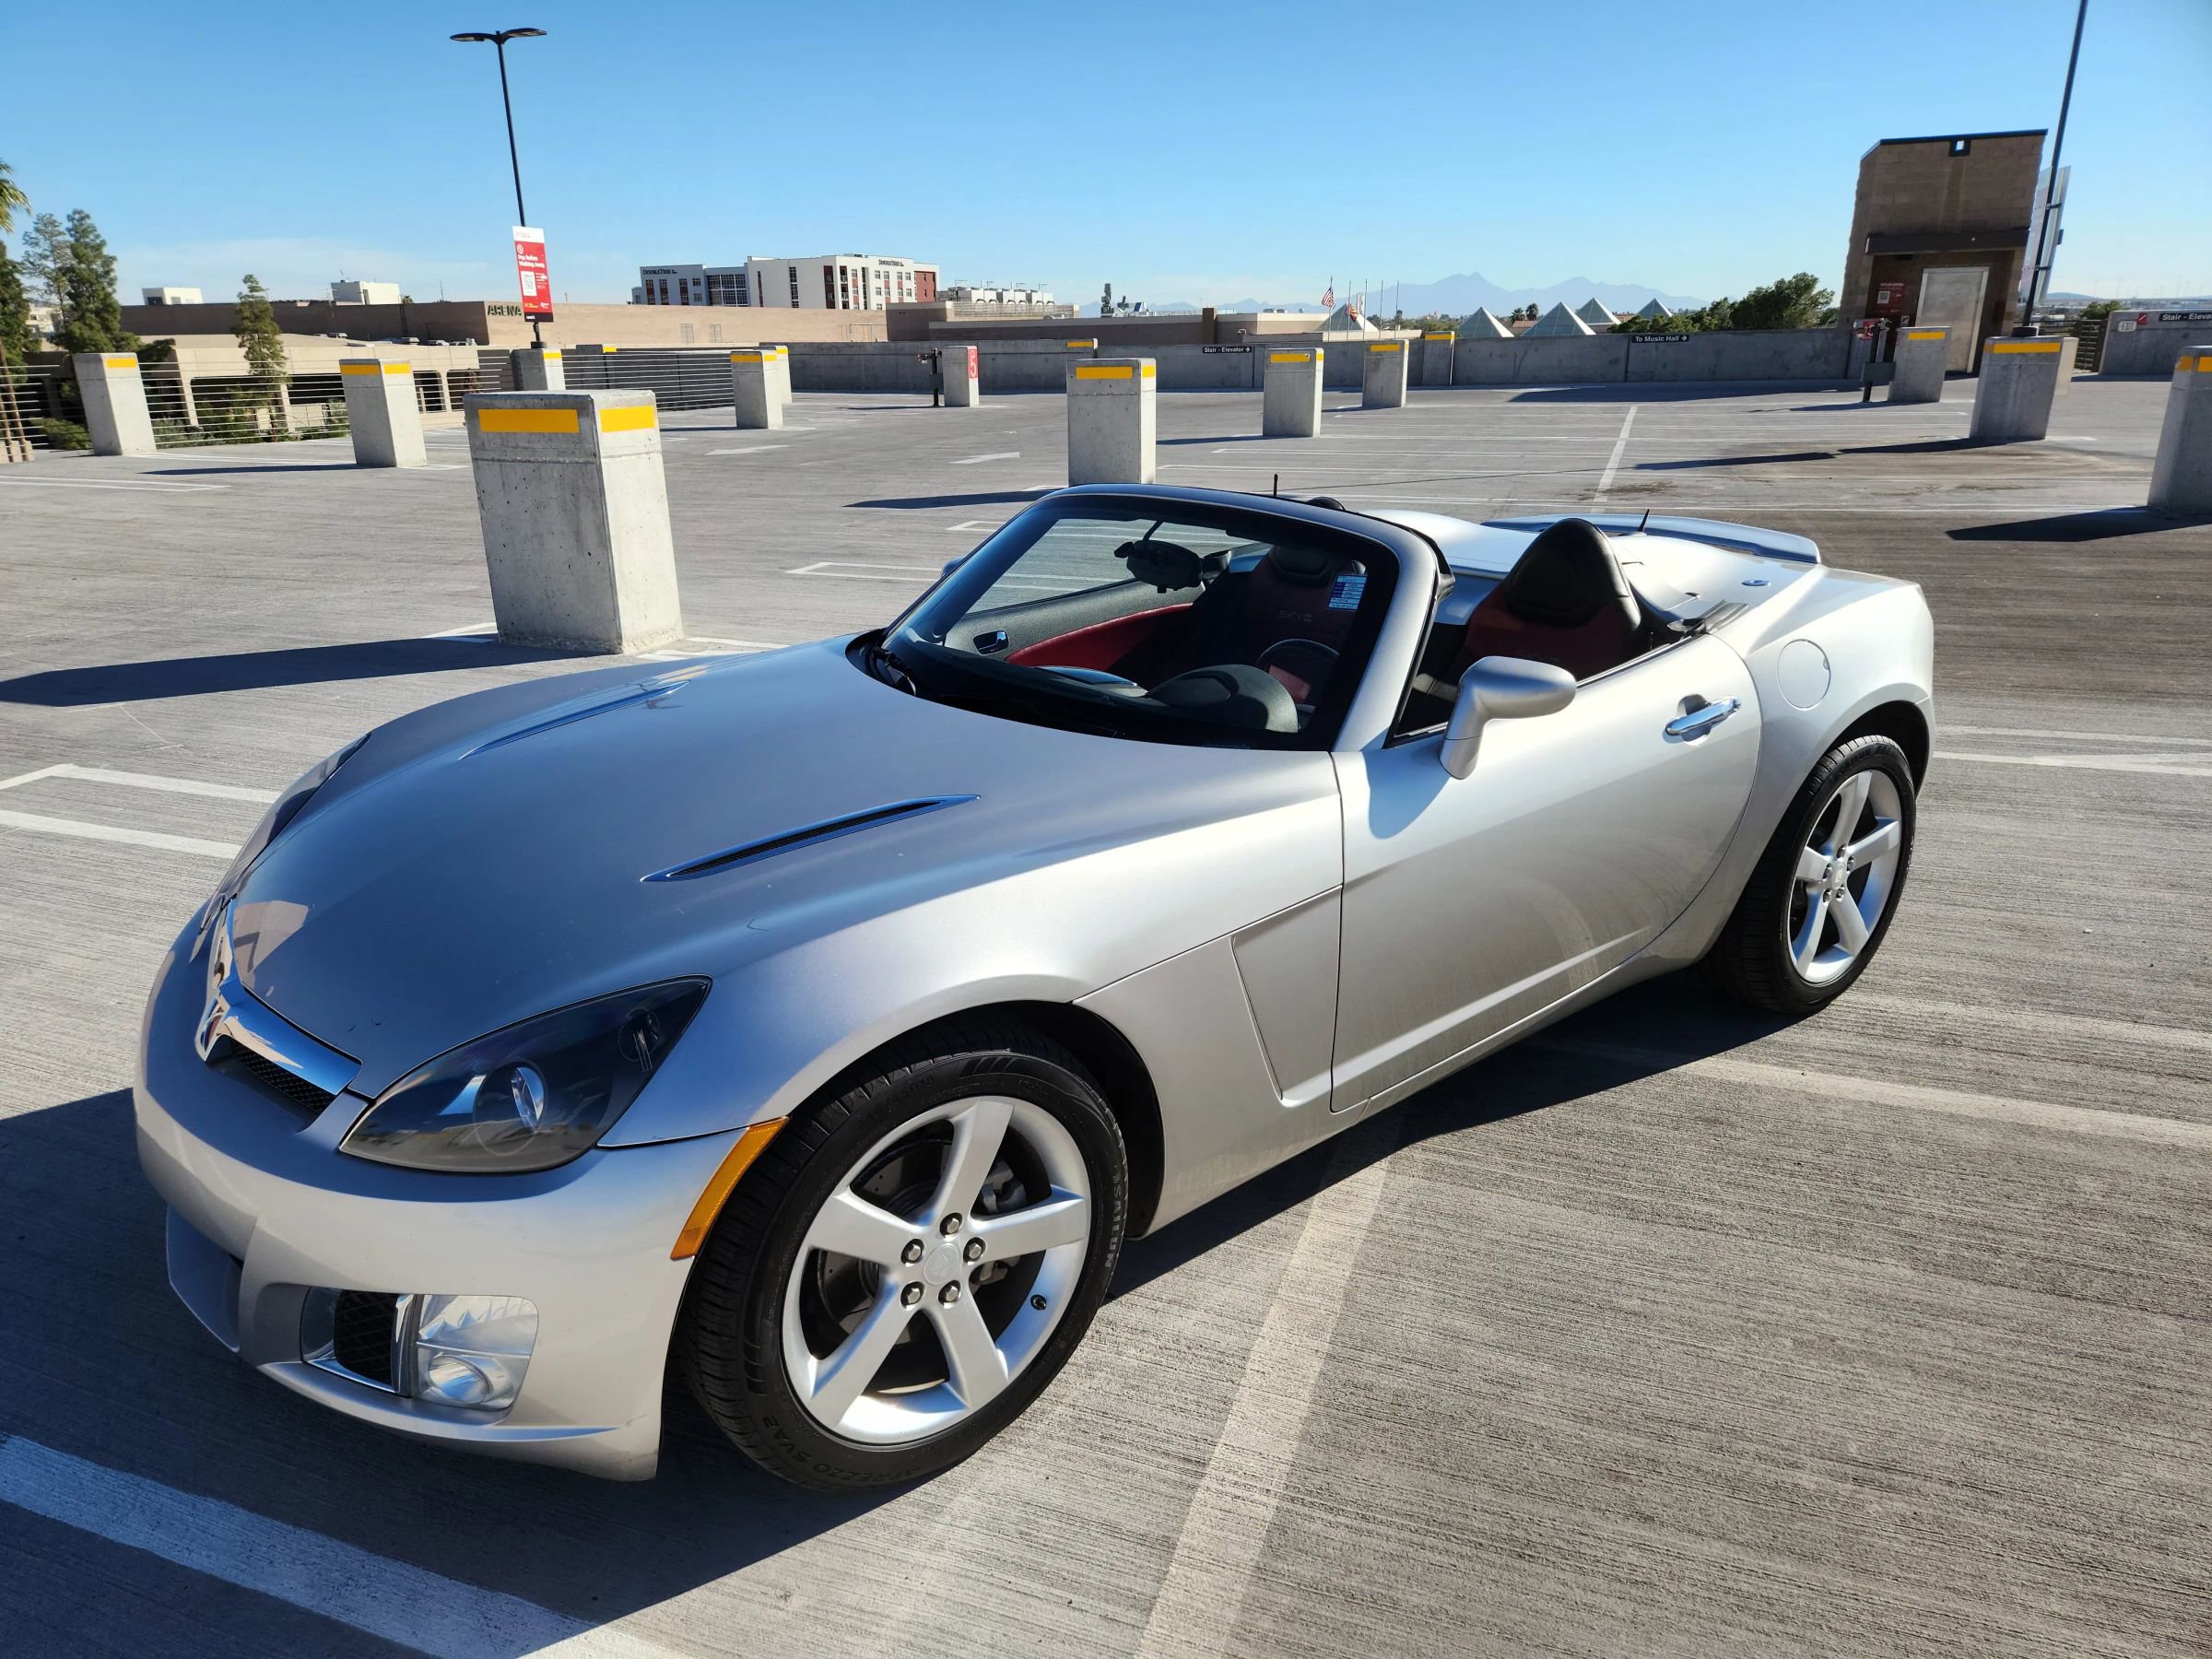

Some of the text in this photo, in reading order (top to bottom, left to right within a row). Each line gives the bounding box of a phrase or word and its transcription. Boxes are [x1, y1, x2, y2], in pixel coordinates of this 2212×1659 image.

[488, 305, 523, 316] ARENA
[970, 354, 977, 378] 5
[1104, 1183, 1123, 1268] SAILUN
